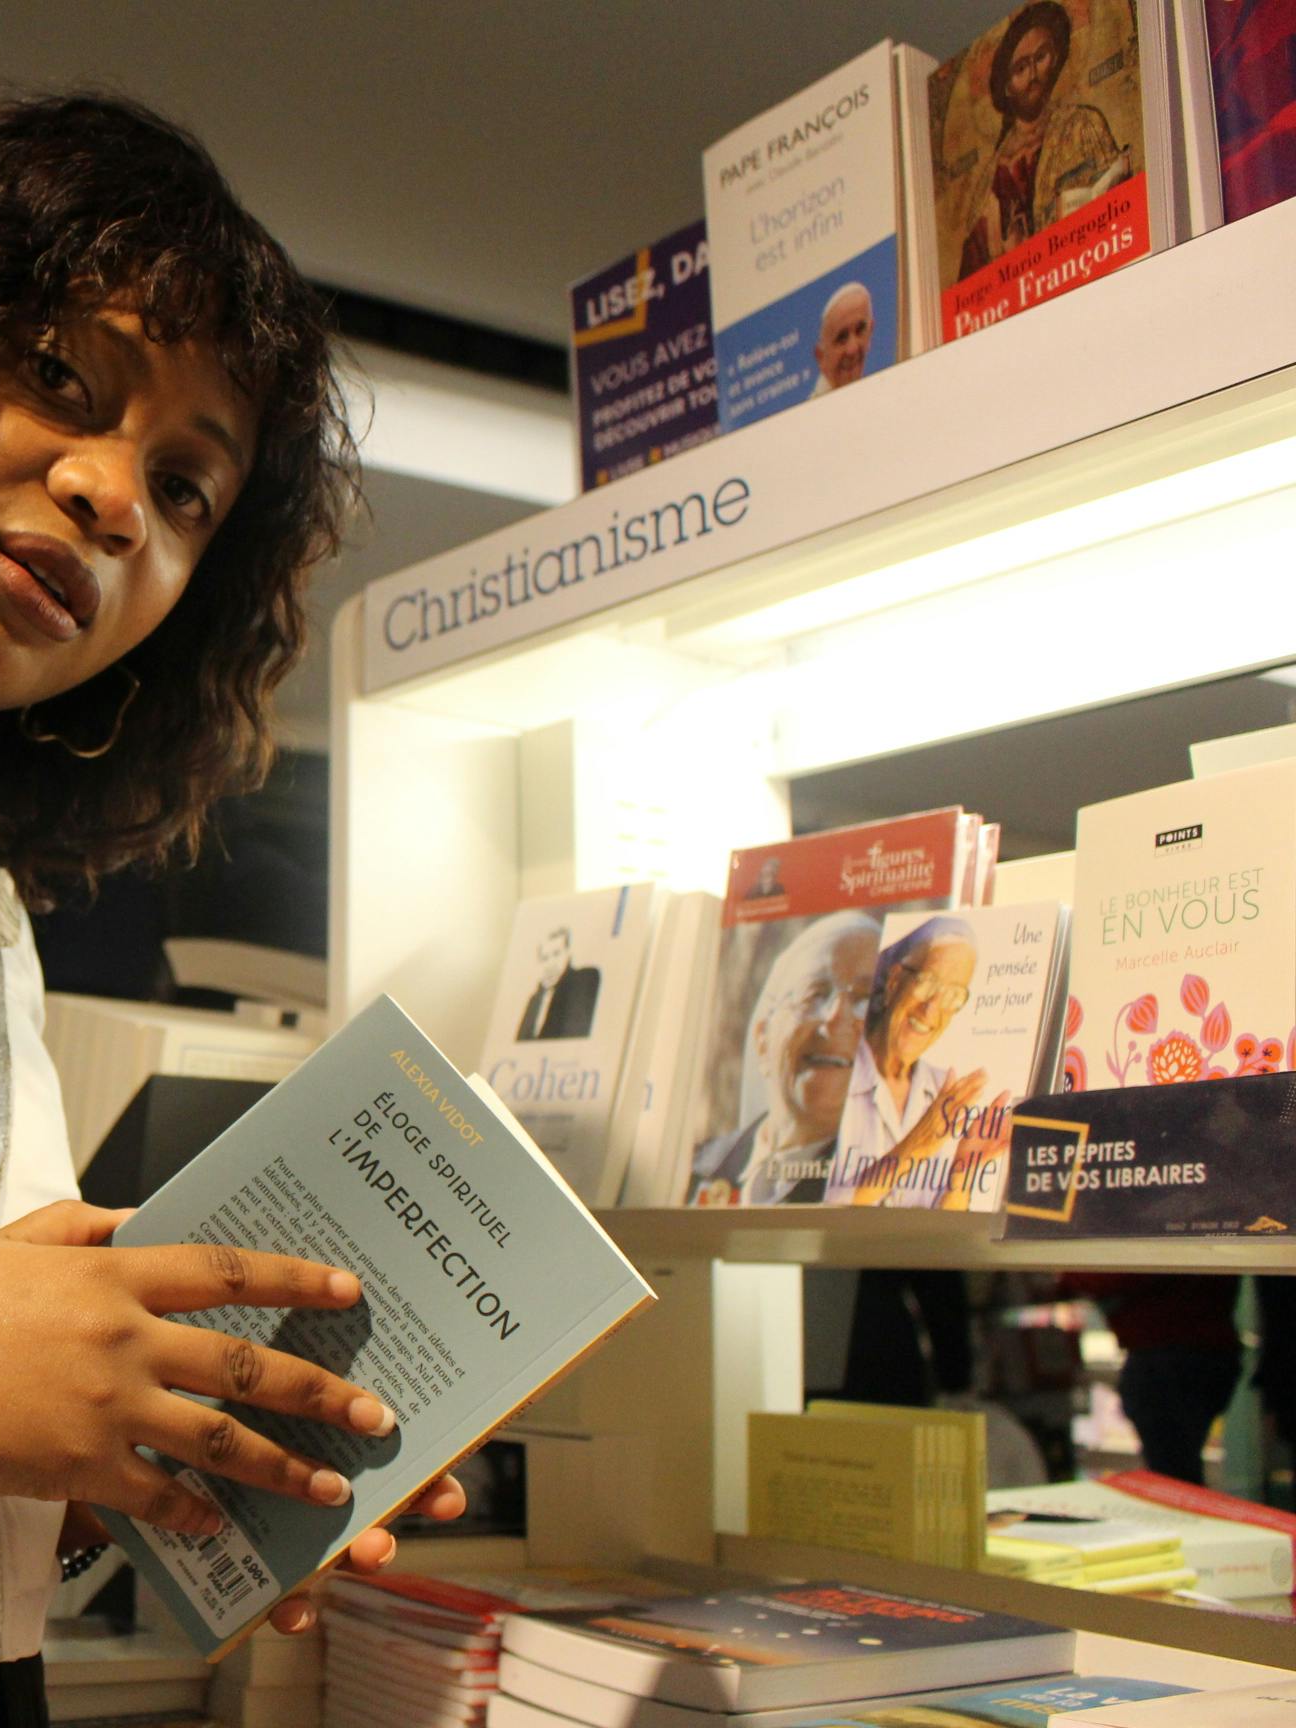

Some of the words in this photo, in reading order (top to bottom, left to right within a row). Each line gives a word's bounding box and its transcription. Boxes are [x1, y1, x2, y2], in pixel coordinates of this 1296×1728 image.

[719, 148, 761, 190] PAPE
[767, 84, 870, 160] FRANÇOIS
[750, 176, 846, 246] L'horizon
[754, 240, 788, 272] est
[794, 211, 845, 252] infini
[586, 268, 666, 328] LISEZ,
[671, 240, 711, 285] DA
[955, 282, 995, 314] Jorge
[998, 250, 1043, 285] Mario
[1046, 199, 1132, 256] Bergoglio
[1017, 223, 1134, 308] François
[590, 350, 651, 395] VOUS
[654, 323, 707, 366] AVEZ
[693, 355, 719, 382] VO
[382, 477, 753, 653] Christianisme
[1158, 826, 1200, 846] POINTS
[1099, 896, 1119, 917] LE
[1124, 876, 1222, 911] BONHEUR
[1228, 867, 1265, 891] EST
[1102, 910, 1144, 946] EN
[1157, 889, 1261, 935] VOUS
[1012, 922, 1044, 945] Une
[1114, 948, 1180, 972] Marcelle
[1183, 940, 1241, 960] Auclair
[986, 955, 1038, 986] pensée
[973, 993, 1002, 1017] par
[1000, 986, 1033, 1016] jour
[389, 1049, 441, 1103] ALEXIA
[435, 1098, 485, 1147] VIDOT
[488, 1055, 602, 1101] Cohen
[352, 1108, 382, 1140] DE
[936, 1095, 1012, 1142] Sœur
[372, 1091, 431, 1155] ÉLOGE
[427, 1153, 510, 1248] SPIRITUEL
[765, 1157, 834, 1183] Emma
[828, 1146, 998, 1195] Emmanuelle
[1025, 1145, 1059, 1168] LES
[1025, 1172, 1053, 1193] DE
[1057, 1169, 1102, 1191] VOS
[1106, 1162, 1207, 1188] LIBRAIRES
[328, 1128, 520, 1340] L'IMPERFECTION
[238, 1184, 262, 1207] peut
[260, 1205, 297, 1247] s'extraire
[393, 1361, 431, 1407] condition
[250, 1175, 285, 1213] sommes
[288, 1216, 304, 1234] des
[375, 1316, 392, 1334] des
[388, 1333, 415, 1365] anges.
[414, 1361, 434, 1384] Nul
[429, 1382, 443, 1397] ne
[261, 1163, 302, 1212] idéalisées,
[301, 1209, 314, 1220] il
[323, 1235, 357, 1271] urgence
[362, 1279, 401, 1322] consentir
[406, 1330, 418, 1344] ce
[416, 1343, 434, 1363] que
[431, 1362, 454, 1388] nous
[272, 1154, 296, 1179] Pour
[292, 1178, 306, 1192] ne
[301, 1190, 323, 1213] plus
[319, 1210, 350, 1240] porter
[345, 1239, 360, 1254] au
[355, 1251, 388, 1286] pinacle
[385, 1284, 403, 1304] des
[400, 1300, 430, 1335] figures
[426, 1331, 456, 1367] idéales
[453, 1366, 466, 1379] et
[217, 1203, 258, 1250] pauvretés,
[371, 1377, 410, 1425] Comment
[229, 1193, 250, 1216] avec
[252, 1218, 269, 1237] son
[354, 1337, 411, 1400] contrariétés,
[407, 1401, 421, 1416] de
[229, 1318, 245, 1335] de
